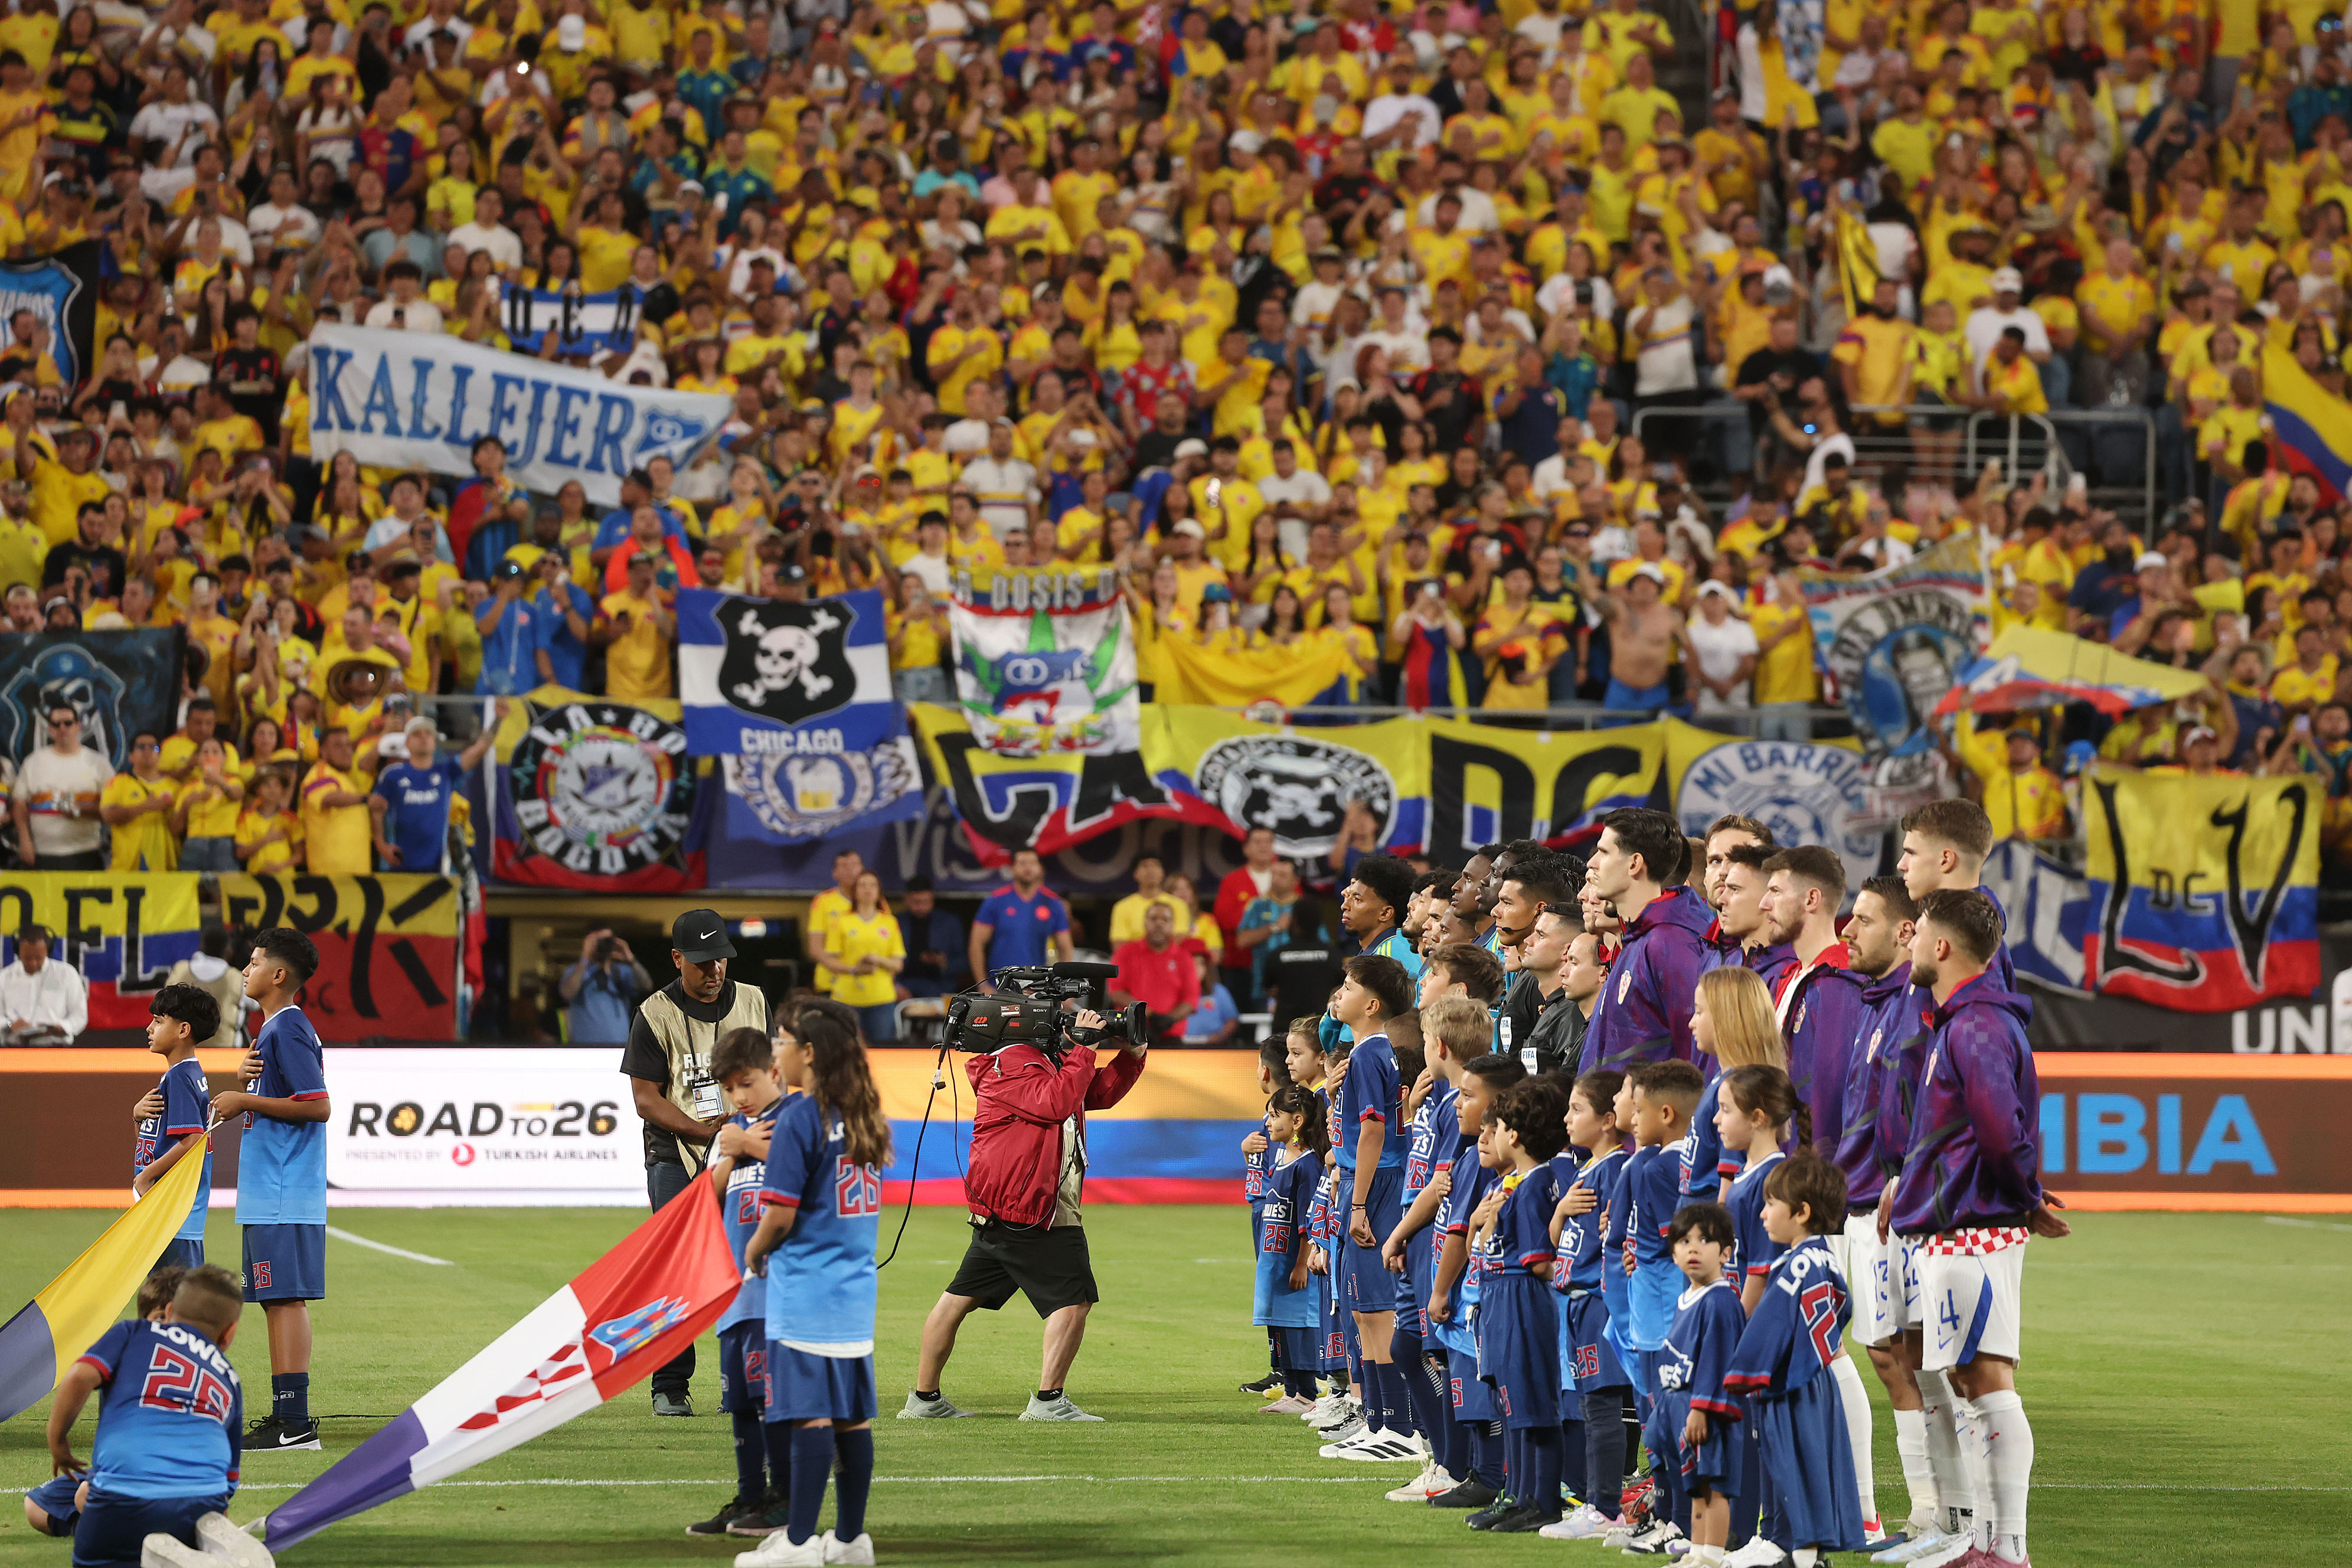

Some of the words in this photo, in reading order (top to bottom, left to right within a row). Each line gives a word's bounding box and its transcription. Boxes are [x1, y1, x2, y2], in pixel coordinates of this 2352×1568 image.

[312, 345, 636, 477] KALLEJER
[740, 727, 844, 755] CHICAGO
[1694, 759, 1736, 799] MI
[2148, 868, 2217, 916] DC
[683, 1053, 712, 1069] RIG
[1523, 1050, 1535, 1059] FIFA
[348, 1102, 503, 1136] ROAD
[510, 1117, 547, 1136] TO
[552, 1101, 619, 1136] 26
[135, 1137, 156, 1167] 26
[346, 1149, 423, 1161] PRESENTED
[426, 1149, 442, 1161] BY
[484, 1148, 547, 1161] TURKISH
[554, 1148, 618, 1161] AIRLINES
[835, 1154, 881, 1219] 26
[1263, 1223, 1291, 1254] 26
[1941, 1289, 1961, 1331] 4
[1576, 1343, 1600, 1378] 26
[139, 1342, 233, 1425] 26
